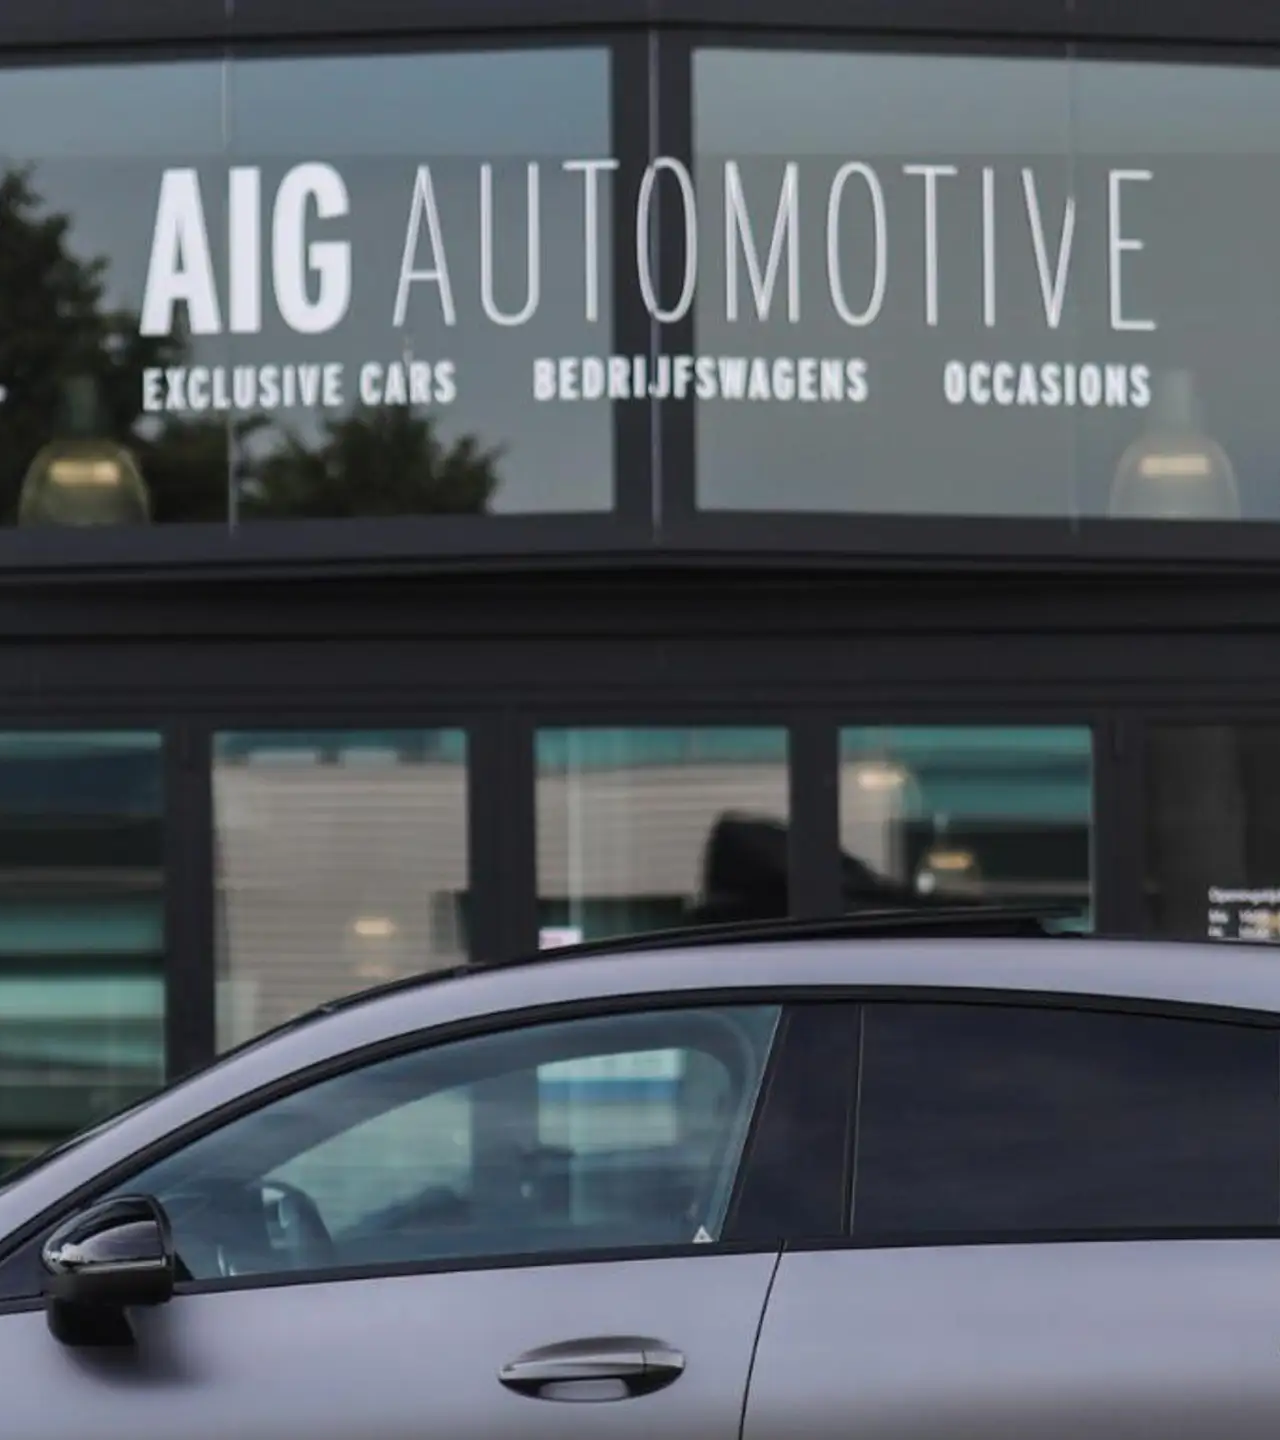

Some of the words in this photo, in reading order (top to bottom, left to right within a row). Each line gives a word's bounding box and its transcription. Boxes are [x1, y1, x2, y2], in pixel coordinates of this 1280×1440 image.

[140, 162, 352, 336] AIG
[392, 157, 1158, 331] AUTOMOTIVE
[142, 364, 344, 411] EXCLUSIVE
[359, 361, 457, 406] CARS
[534, 356, 870, 404] BEDRIJFSWAGENS
[943, 362, 1151, 408] OCCASIONS
